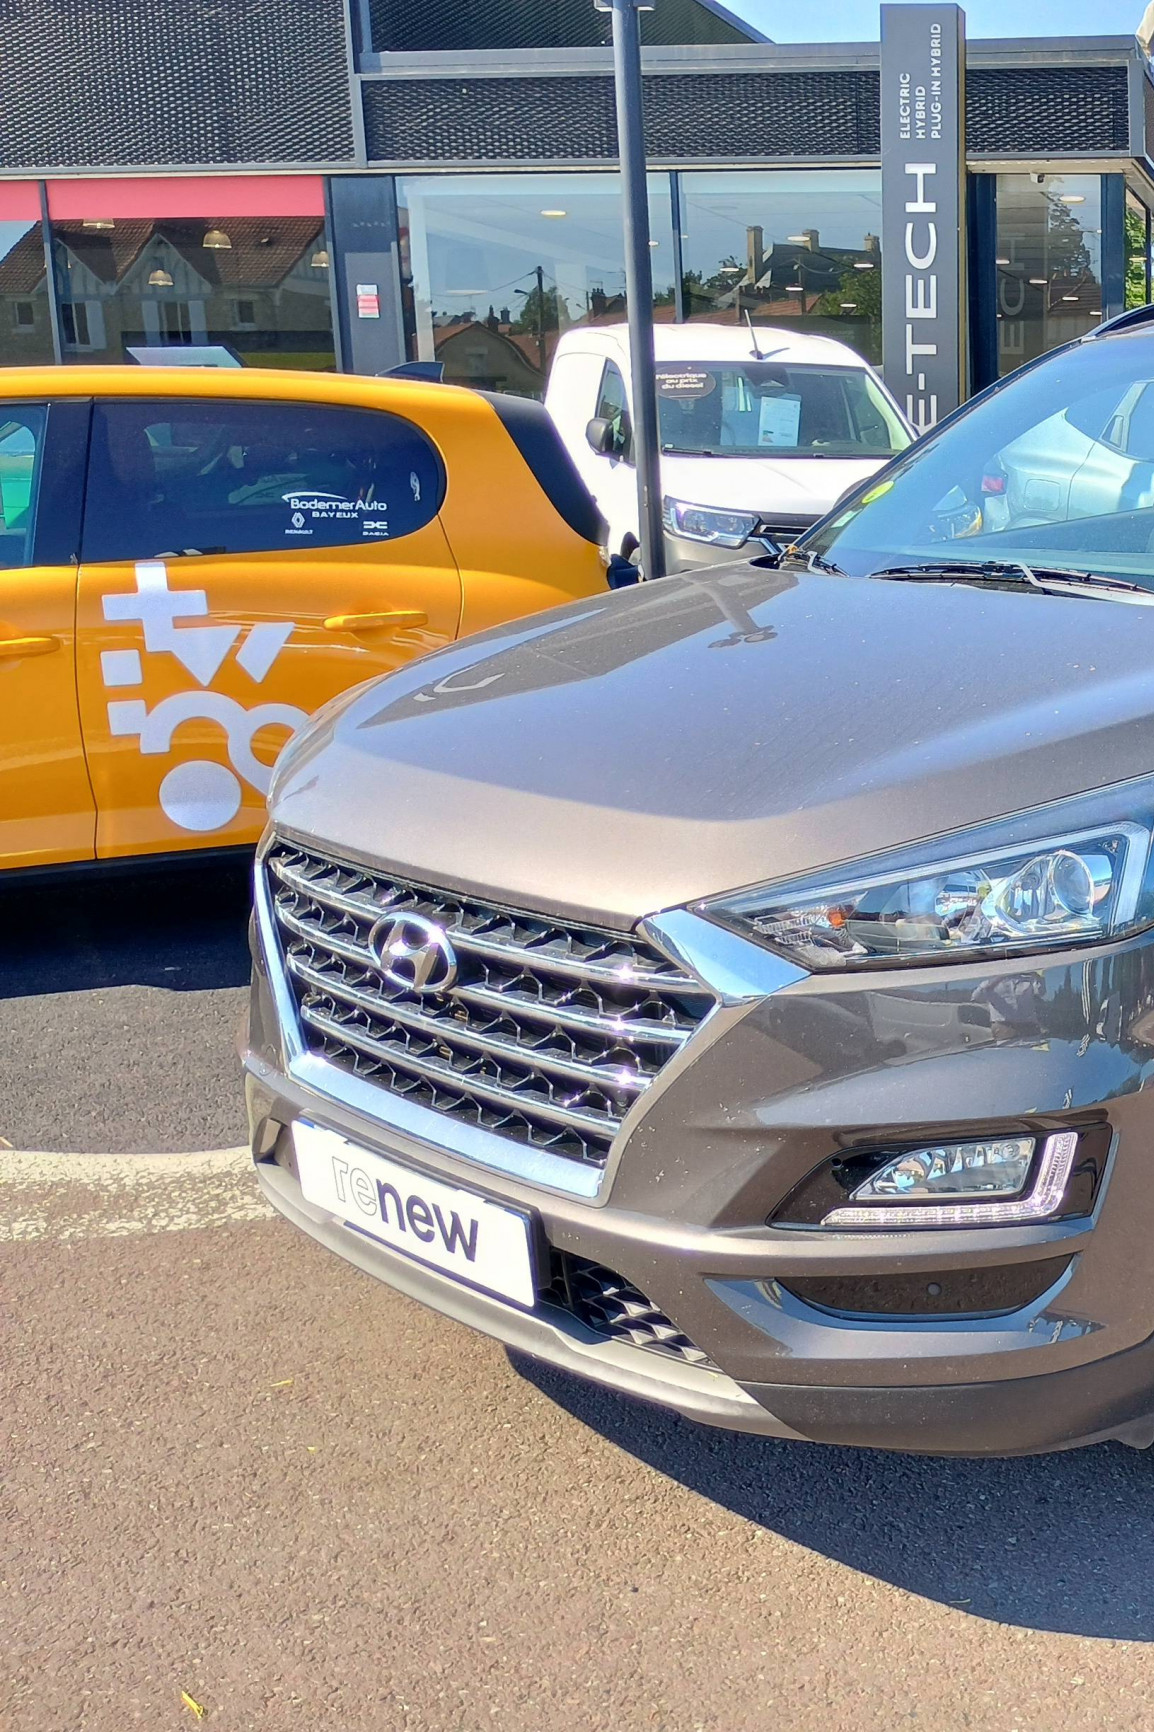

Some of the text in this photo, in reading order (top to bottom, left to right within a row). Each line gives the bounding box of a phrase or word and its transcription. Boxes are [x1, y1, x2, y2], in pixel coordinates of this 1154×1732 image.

[900, 73, 911, 139] ELECTRIC
[915, 86, 926, 139] HYBRID
[930, 23, 942, 139] PLUG-IN HYBRID
[904, 162, 937, 438] E-TECH
[312, 511, 359, 519] BAYEUX
[331, 1155, 479, 1262] renew
